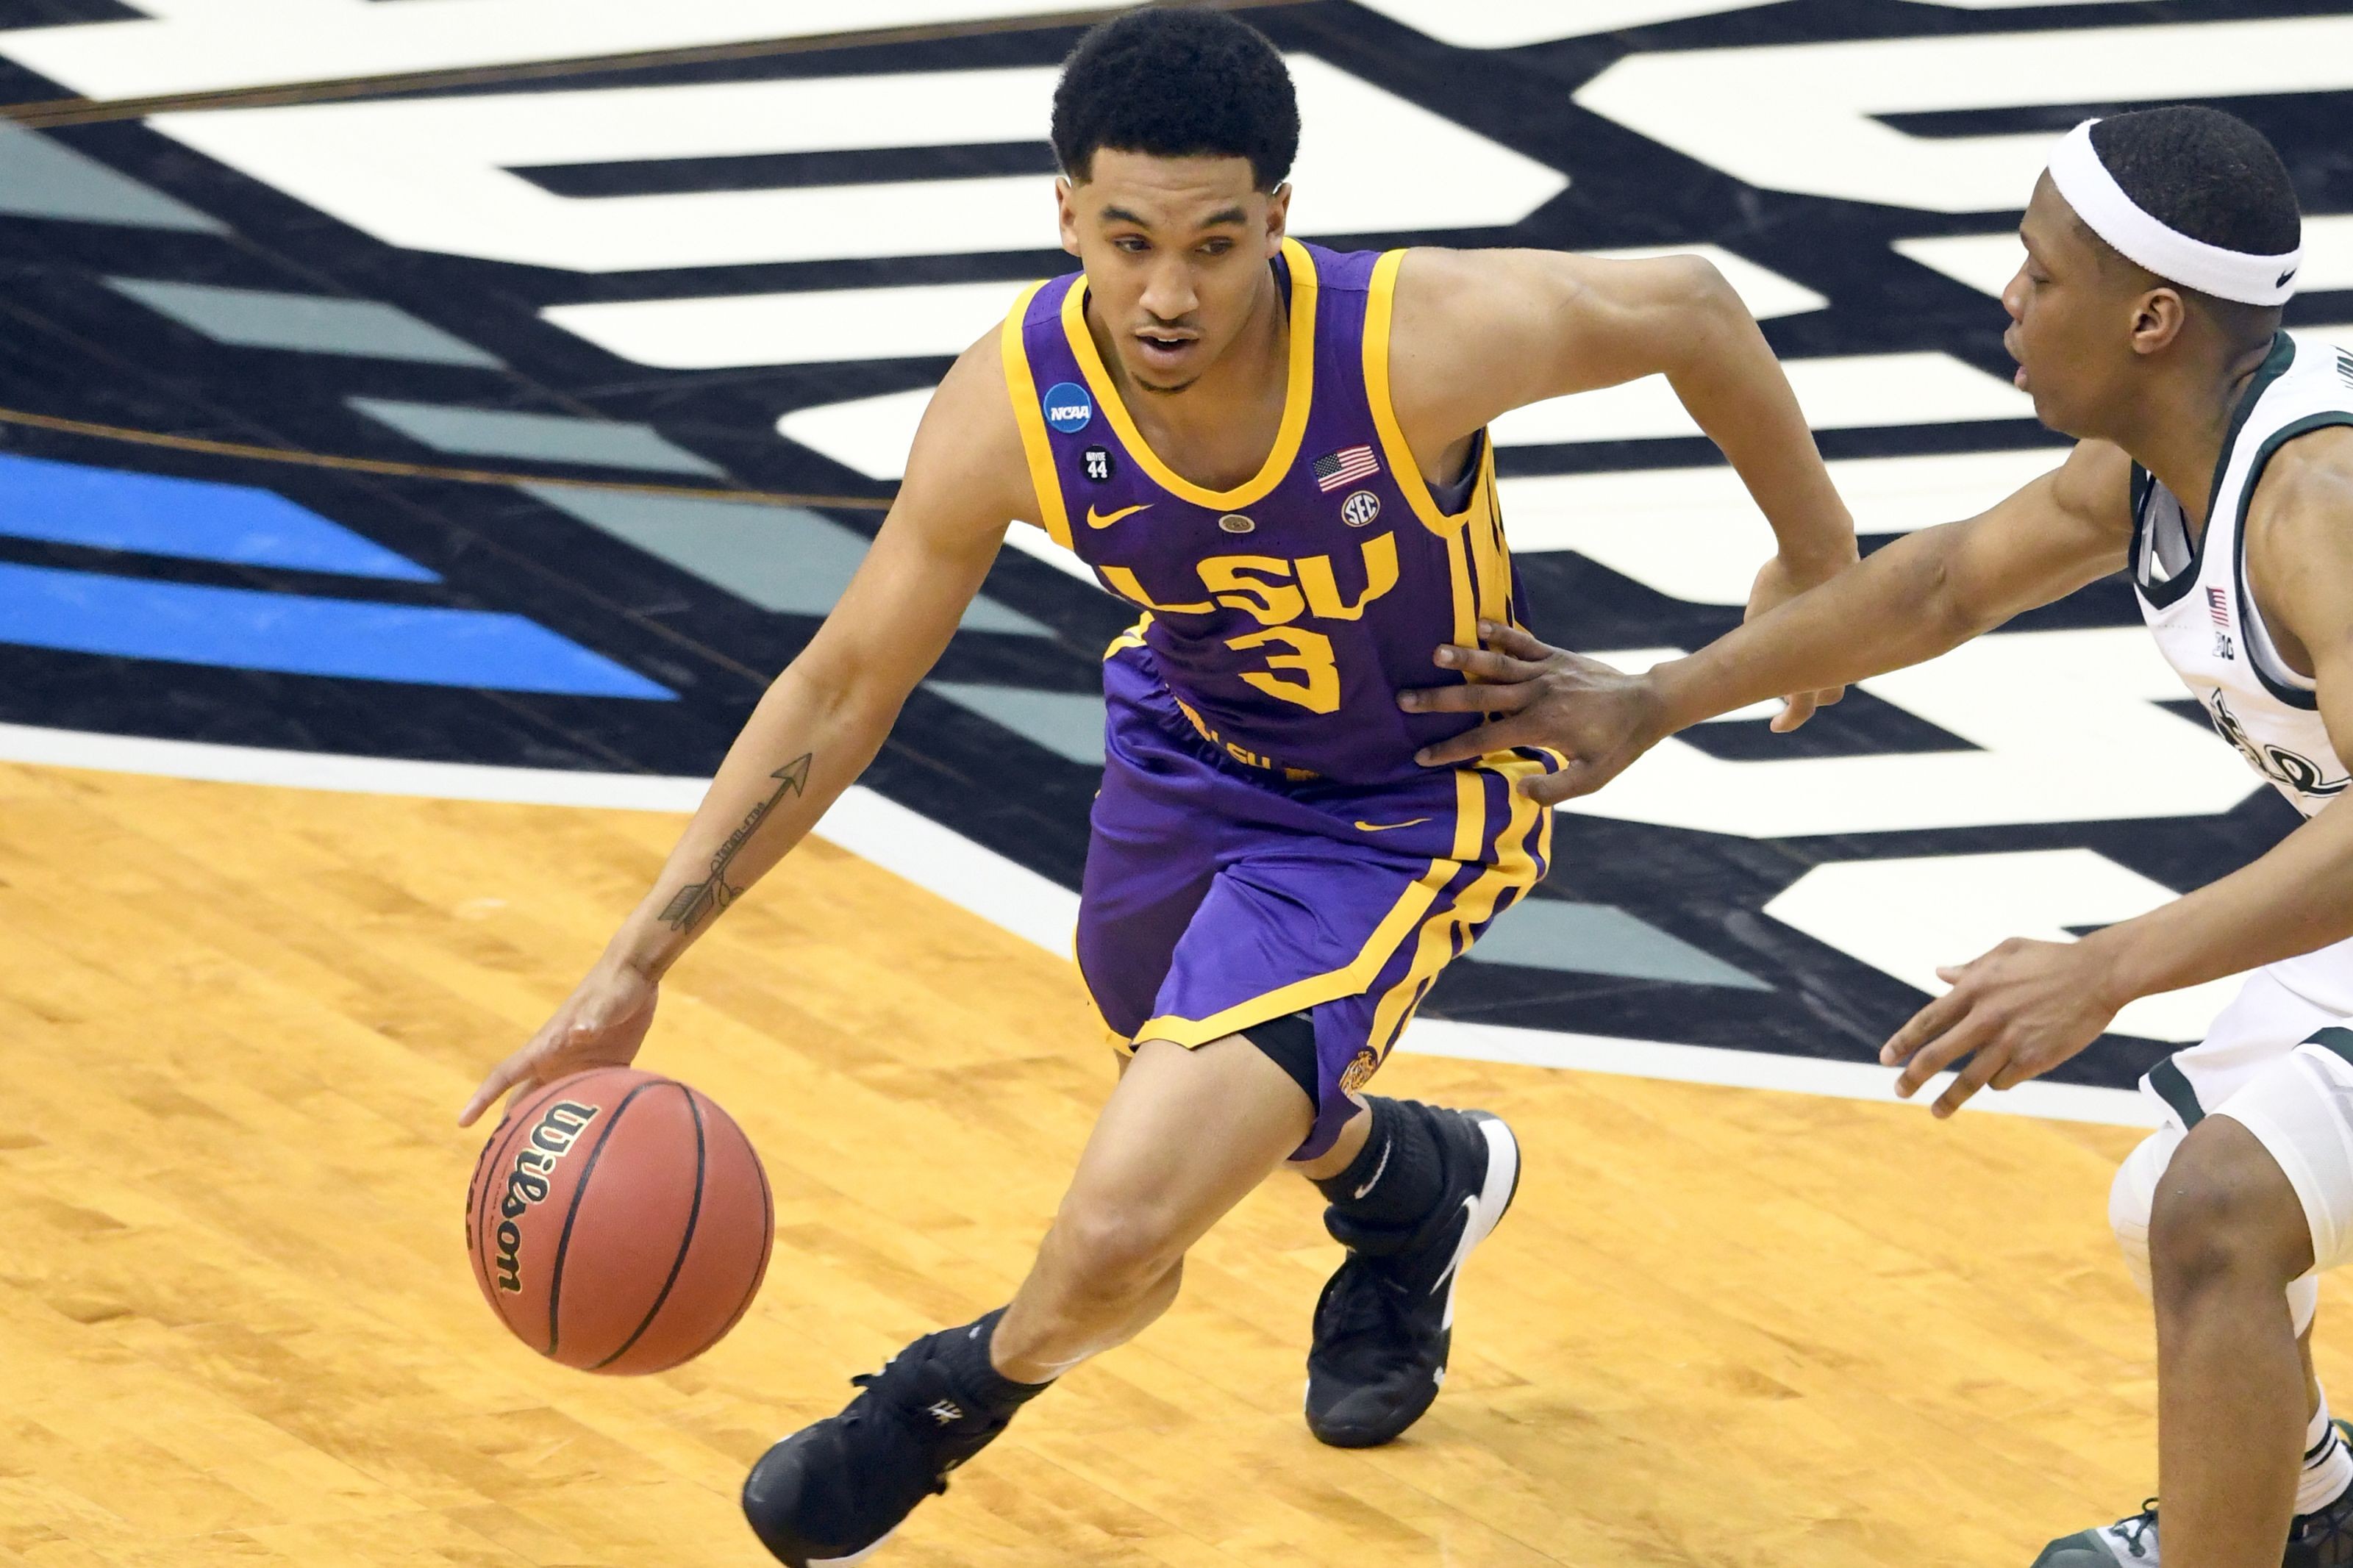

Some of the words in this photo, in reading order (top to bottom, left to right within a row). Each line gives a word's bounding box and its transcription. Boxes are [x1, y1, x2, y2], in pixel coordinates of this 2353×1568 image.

[1051, 406, 1090, 420] NCAA
[1088, 461, 1107, 478] 44
[1345, 493, 1377, 524] SEC
[1099, 531, 1399, 626] LSU
[1224, 626, 1340, 715] 3
[497, 1100, 602, 1295] Wilson
